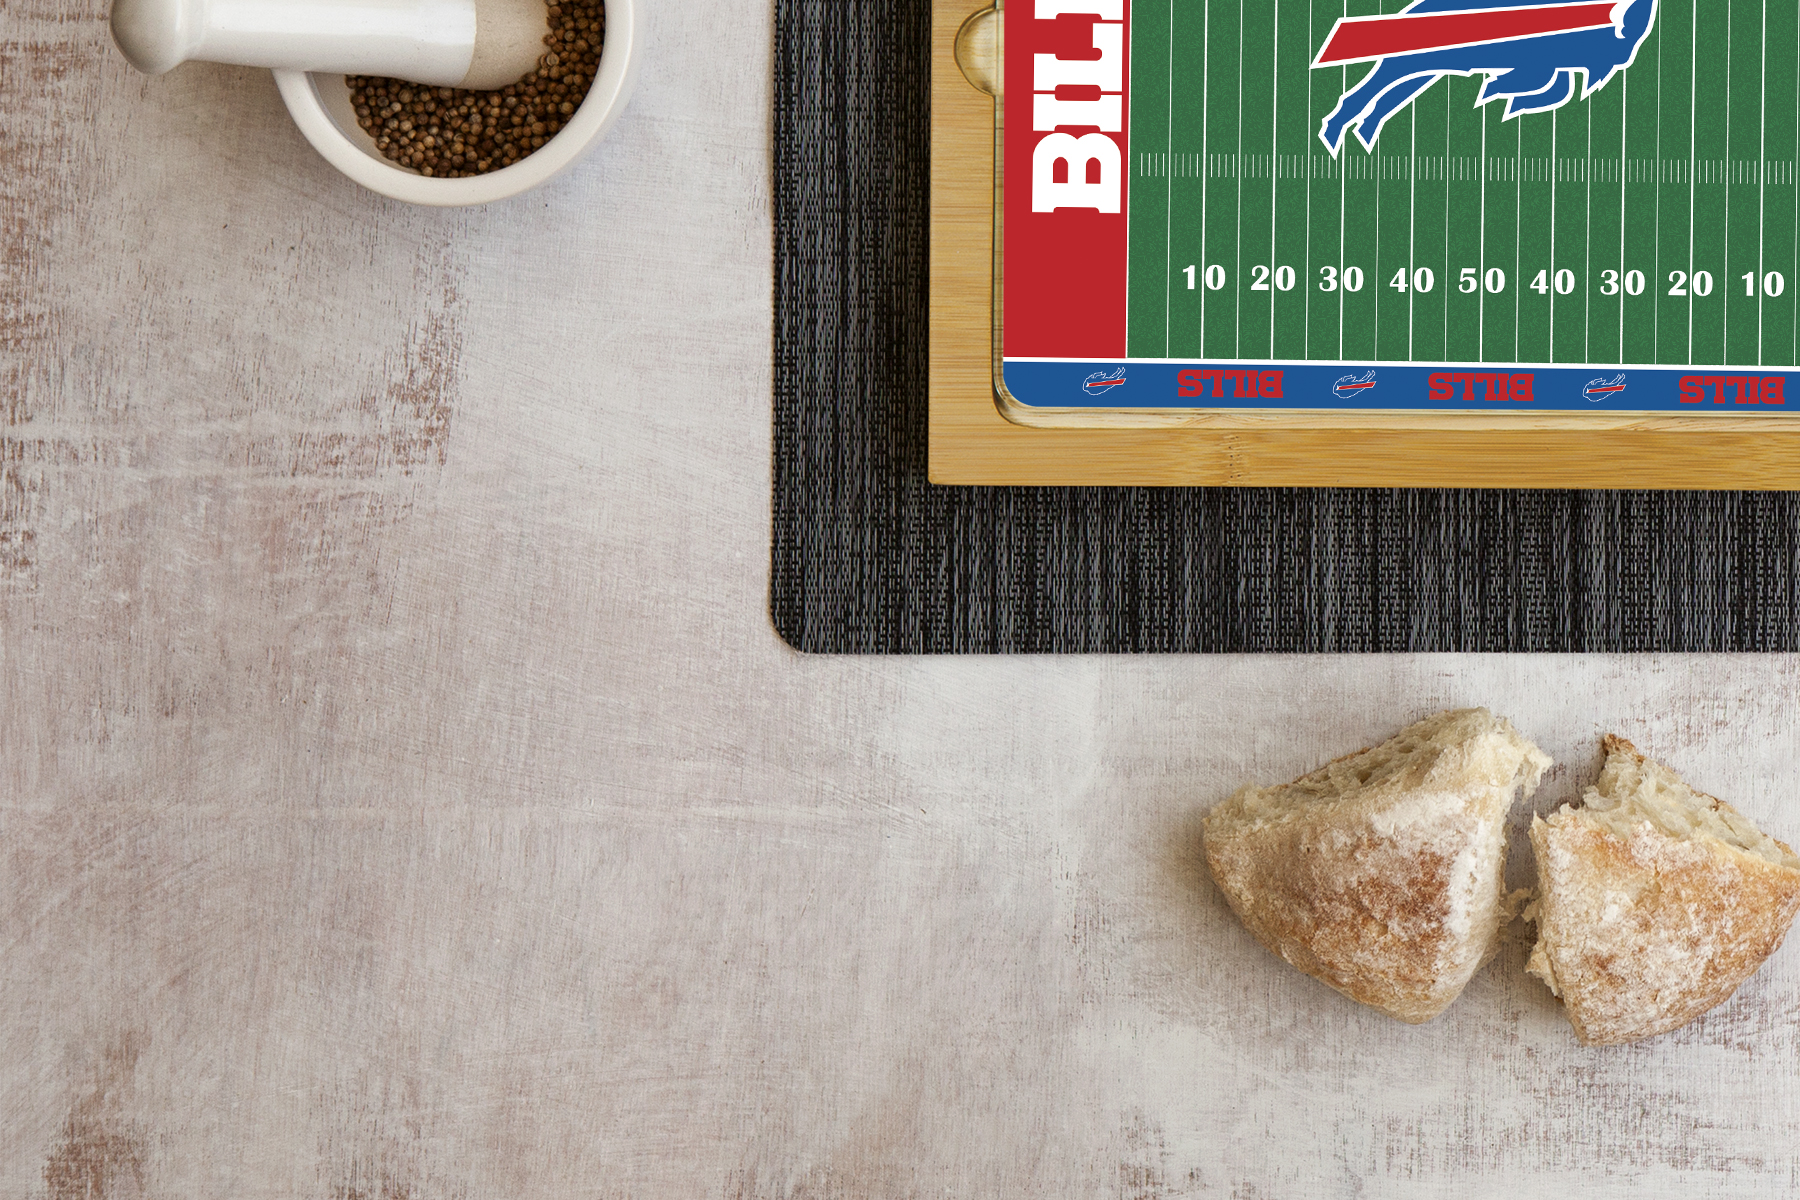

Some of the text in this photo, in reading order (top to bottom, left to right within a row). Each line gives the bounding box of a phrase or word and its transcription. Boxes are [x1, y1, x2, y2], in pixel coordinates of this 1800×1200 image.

[1182, 265, 1785, 297] 10 20 30 40 50 40 30 20 10
[1177, 370, 1284, 399] BILLS
[1428, 373, 1534, 402] BILLS
[1679, 376, 1785, 405] BILLS
